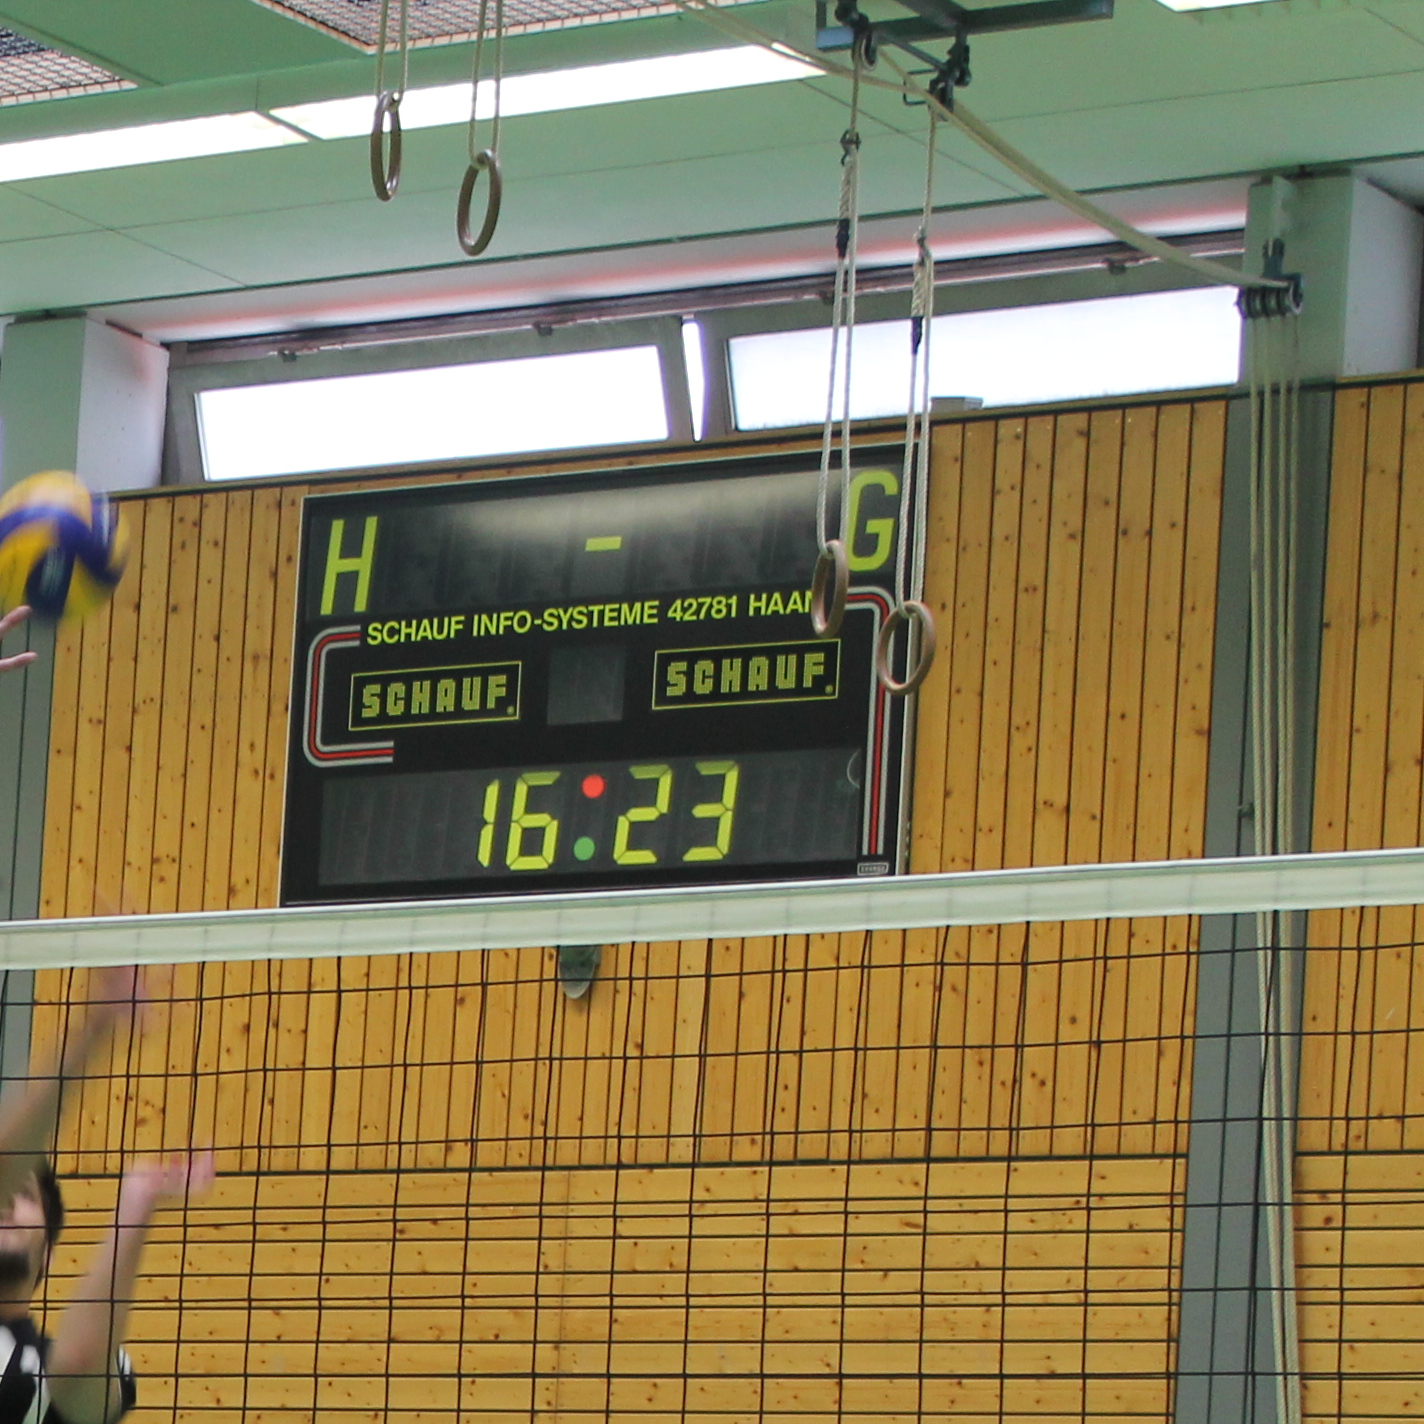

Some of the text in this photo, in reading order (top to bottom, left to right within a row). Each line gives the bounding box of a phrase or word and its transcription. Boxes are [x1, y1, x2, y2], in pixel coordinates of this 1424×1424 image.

[320, 469, 900, 616] H G
[367, 615, 465, 646] SCHAUF
[471, 601, 659, 638] INFO-SYSTEME
[667, 592, 738, 622] 42781
[361, 674, 507, 718] SCHAUF
[666, 652, 825, 697] SCHAUF
